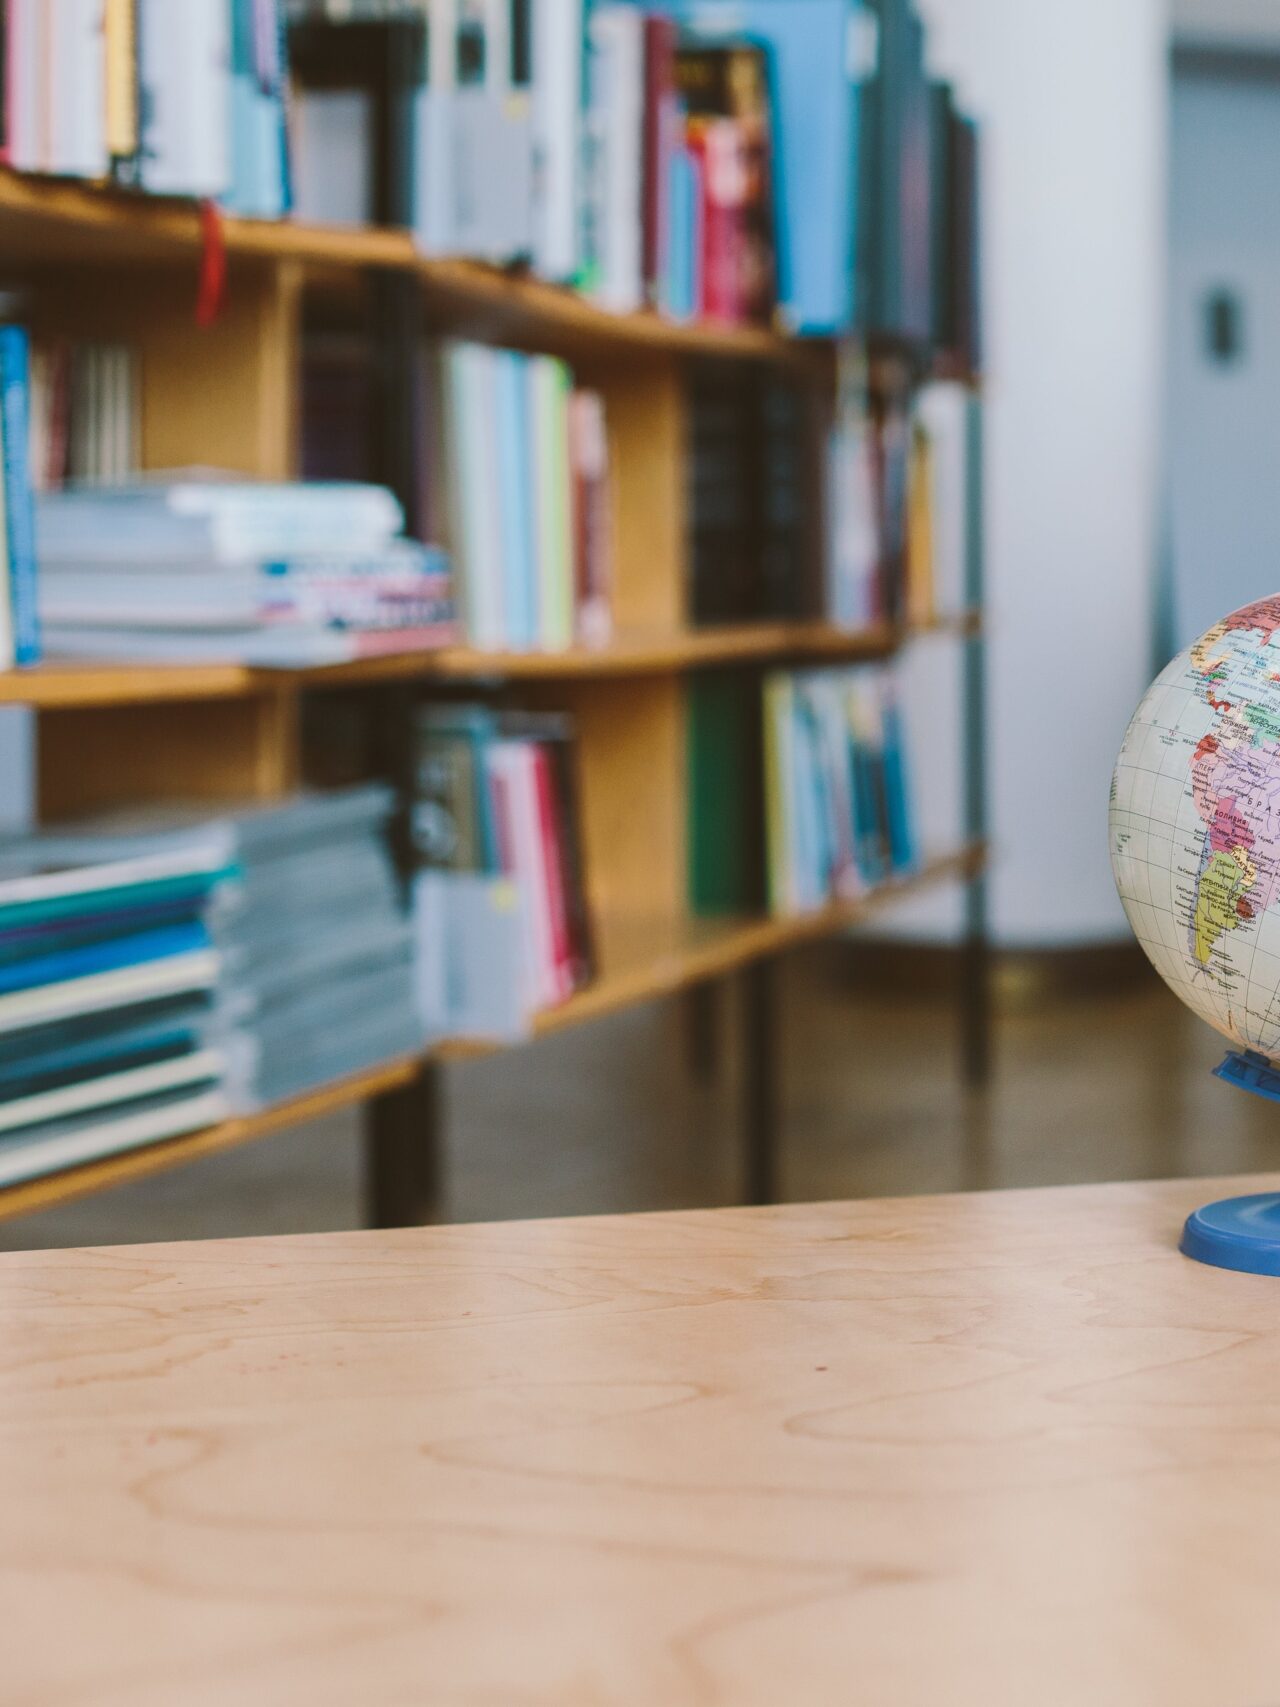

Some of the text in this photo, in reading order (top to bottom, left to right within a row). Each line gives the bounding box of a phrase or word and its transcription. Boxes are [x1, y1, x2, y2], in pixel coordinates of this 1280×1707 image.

[1249, 716, 1280, 733] ВЕНЕСУЭЛА
[1199, 763, 1215, 773] ПЕРУ
[1214, 809, 1247, 826] БОЛИВИЯ
